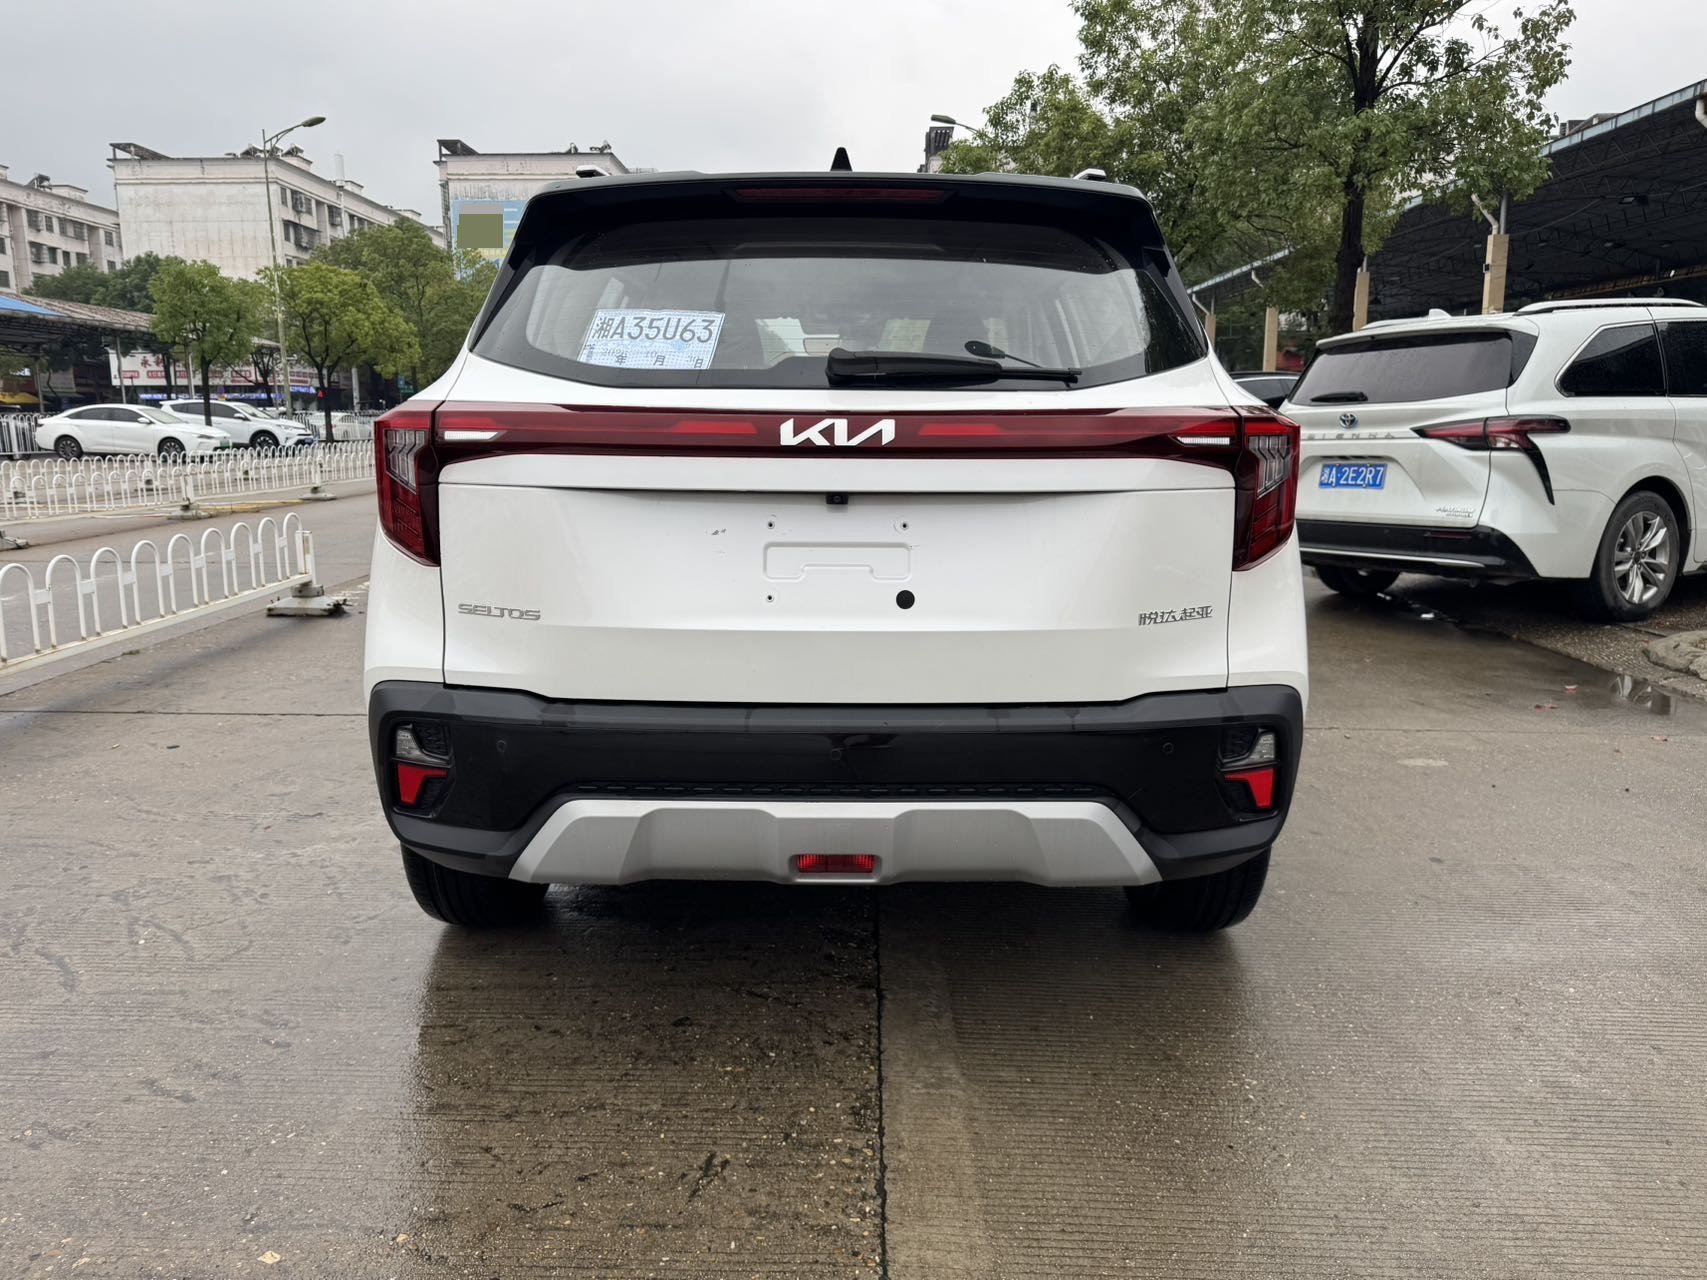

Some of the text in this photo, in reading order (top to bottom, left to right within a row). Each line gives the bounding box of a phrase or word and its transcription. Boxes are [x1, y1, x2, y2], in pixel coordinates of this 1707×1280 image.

[592, 316, 716, 343] 湘A35U63
[780, 418, 896, 446] KIA
[458, 603, 541, 621] SELTOS
[1138, 605, 1213, 626] 悦达起亚
